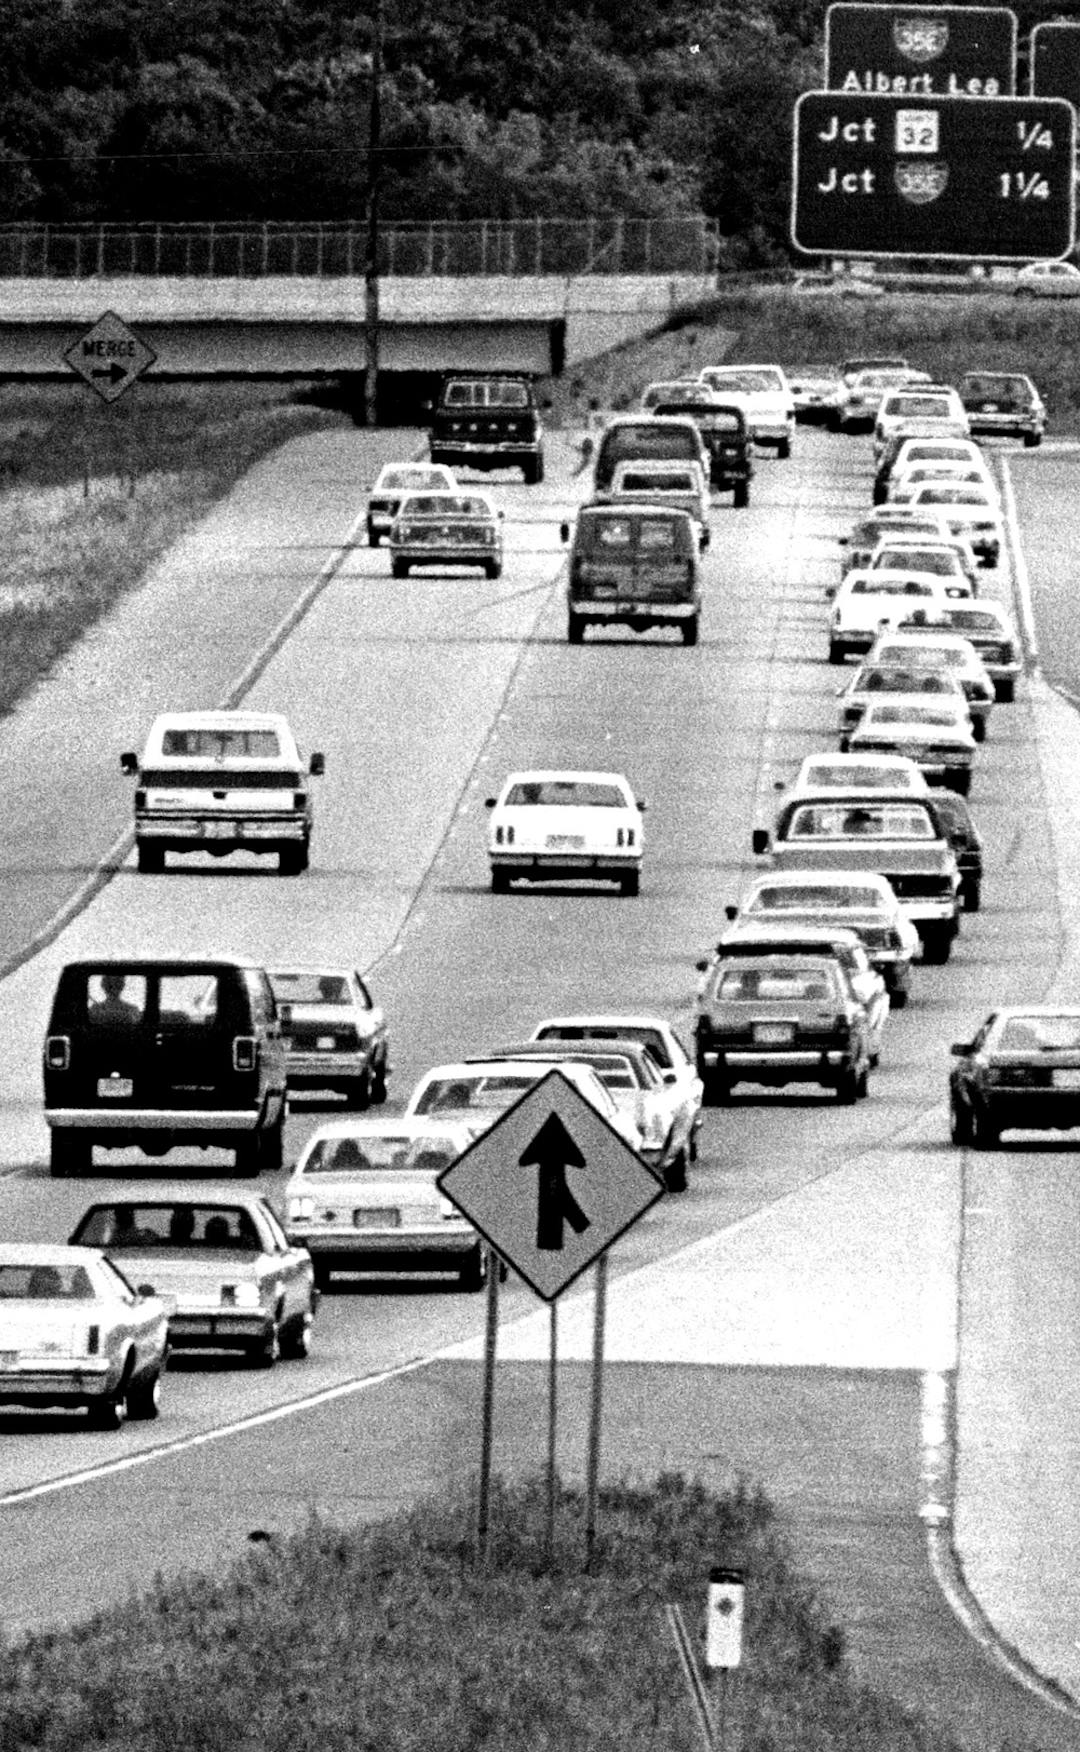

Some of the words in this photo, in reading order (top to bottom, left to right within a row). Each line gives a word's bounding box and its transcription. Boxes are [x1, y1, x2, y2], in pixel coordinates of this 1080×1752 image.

[843, 70, 933, 94] Albert
[949, 73, 999, 96] Lea
[819, 116, 876, 142] Jct
[903, 127, 933, 146] 32
[818, 167, 875, 193] Jct
[83, 340, 136, 357] MERGE
